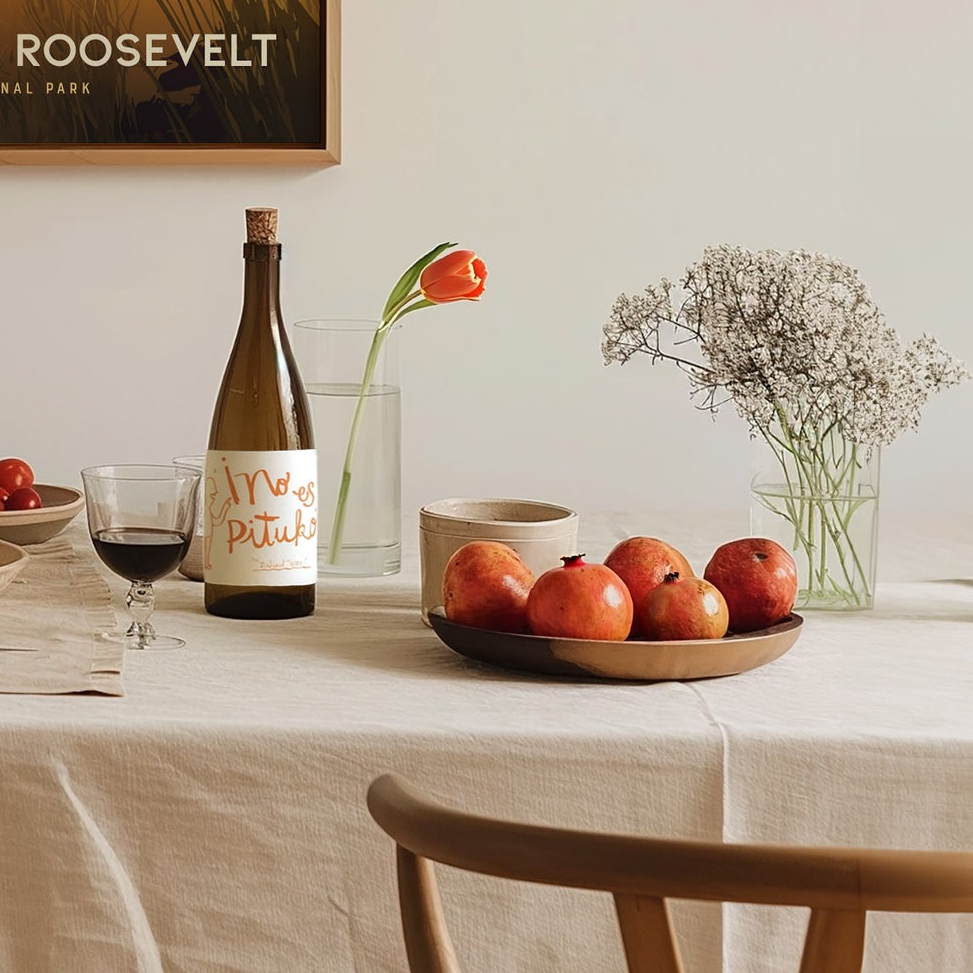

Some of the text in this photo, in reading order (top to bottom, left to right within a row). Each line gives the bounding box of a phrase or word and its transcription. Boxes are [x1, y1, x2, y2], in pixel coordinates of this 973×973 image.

[17, 33, 277, 67] ROOSEVELT
[46, 82, 91, 94] PARK
[292, 481, 315, 507] es
